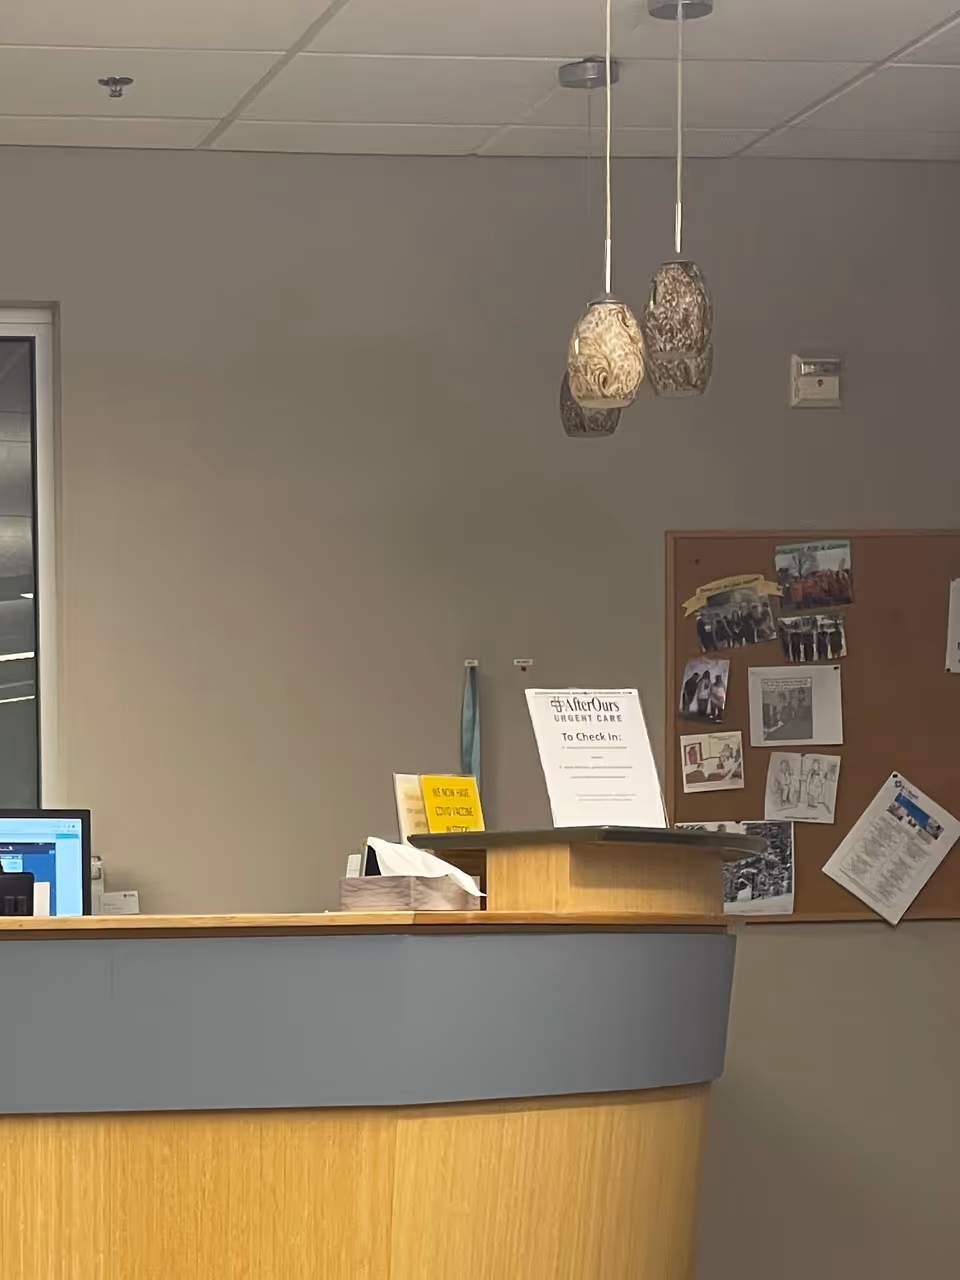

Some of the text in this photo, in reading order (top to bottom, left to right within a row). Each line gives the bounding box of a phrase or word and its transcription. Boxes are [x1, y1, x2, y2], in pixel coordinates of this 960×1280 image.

[565, 697, 620, 712] AfterOurs
[554, 714, 623, 722] URGENT CARE
[561, 732, 622, 741] To Check In:
